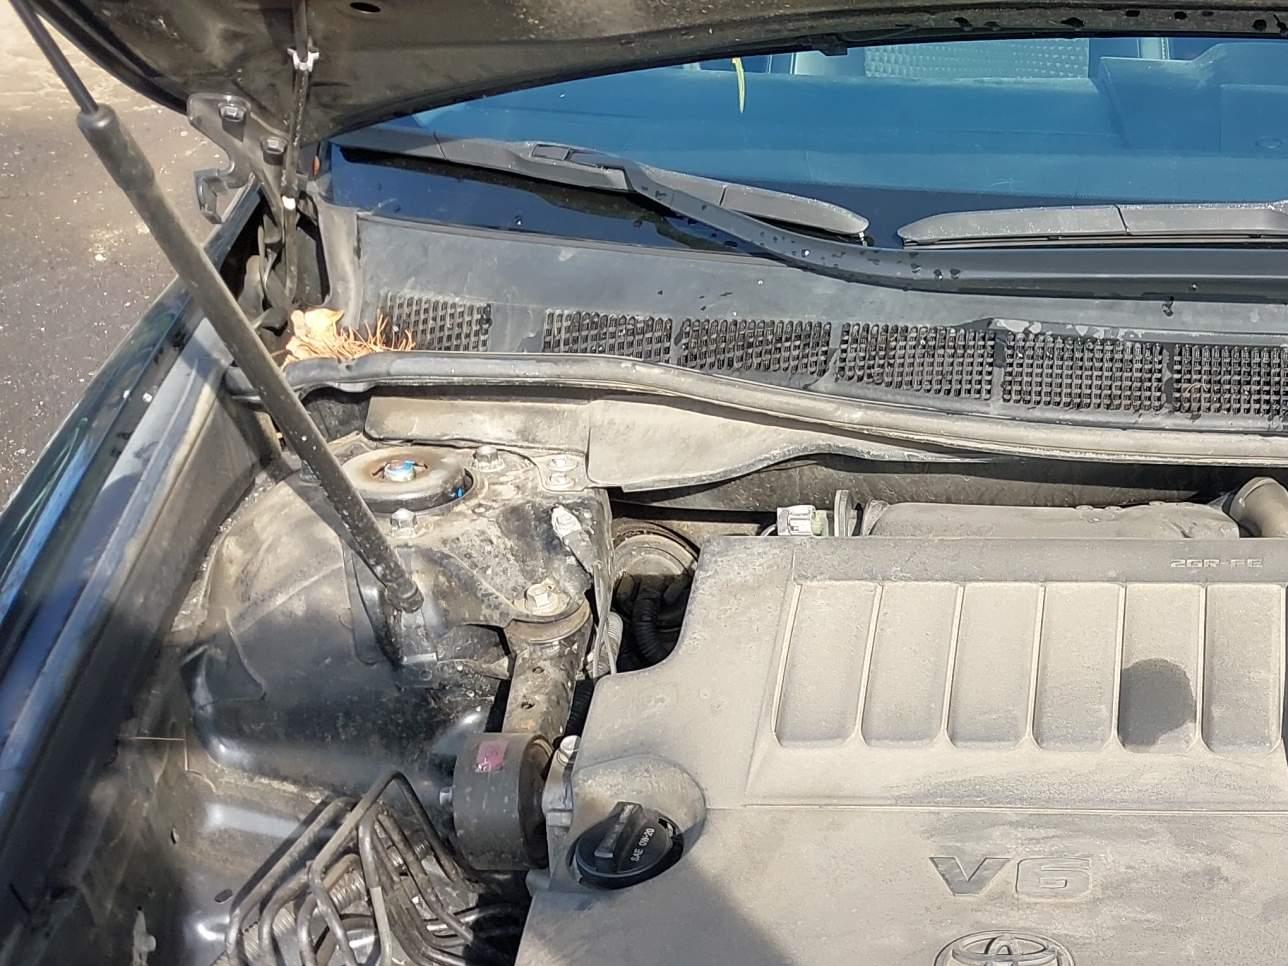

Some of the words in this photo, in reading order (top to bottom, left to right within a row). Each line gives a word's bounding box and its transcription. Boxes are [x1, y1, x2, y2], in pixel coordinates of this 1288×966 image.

[1170, 558, 1263, 569] 2GR-FE
[630, 848, 644, 862] SAE
[928, 856, 1093, 900] V6
